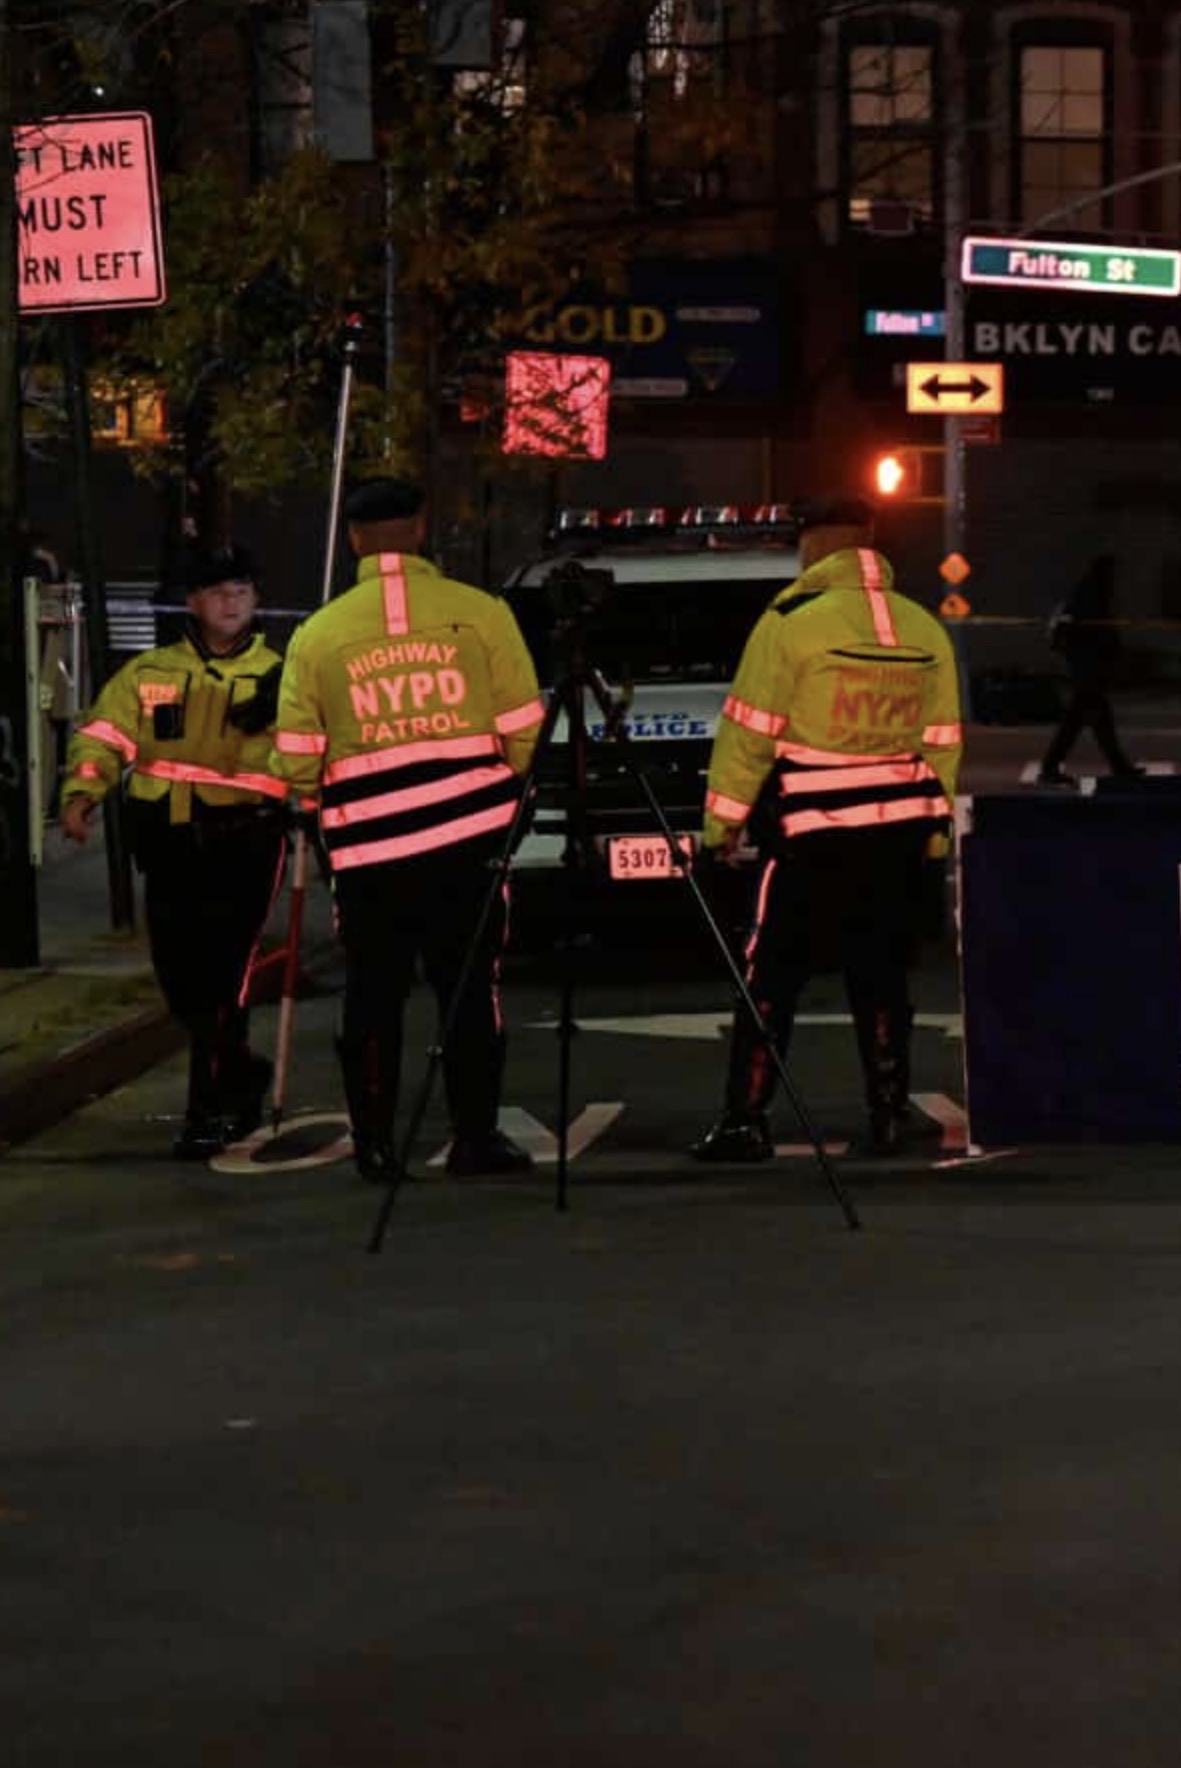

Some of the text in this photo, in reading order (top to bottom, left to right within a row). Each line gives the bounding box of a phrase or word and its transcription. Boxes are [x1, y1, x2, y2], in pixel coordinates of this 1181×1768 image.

[14, 141, 134, 174] FT LANE
[16, 195, 107, 232] MUST
[24, 251, 142, 285] RN LEFT
[1008, 251, 1138, 282] Fulton St
[973, 322, 1115, 356] BKLYN
[346, 642, 459, 681] HIGHWAY
[349, 669, 466, 721] NYPD
[361, 711, 471, 744] PATROL
